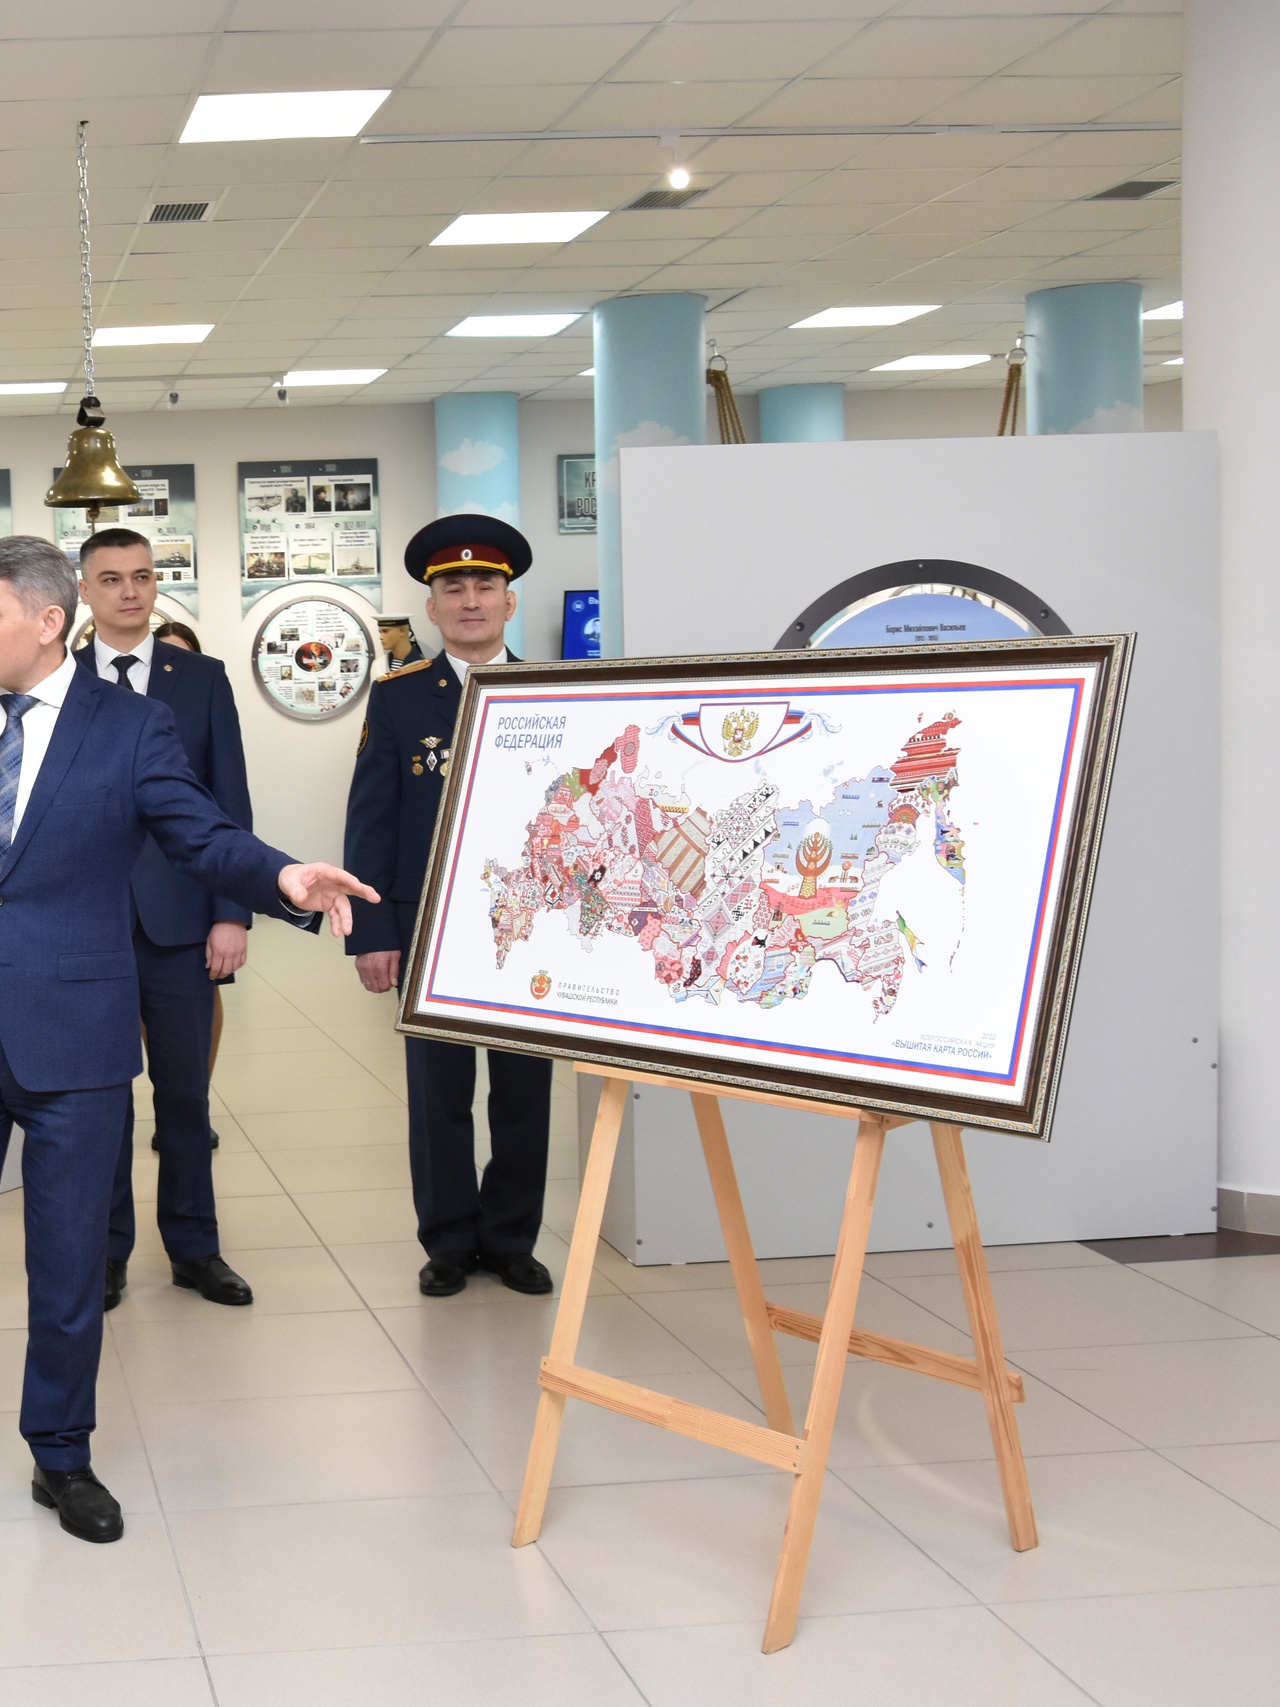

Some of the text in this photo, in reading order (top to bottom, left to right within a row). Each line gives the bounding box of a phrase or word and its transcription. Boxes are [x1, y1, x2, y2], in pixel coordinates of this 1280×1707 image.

[497, 713, 567, 730] РОССИЙСКАЯ
[494, 733, 563, 752] ФЕДЕРАЦИЯ
[557, 981, 621, 997] ПРАВИТЕЛЬСТВО
[556, 991, 619, 1006] ЧУВАШСКОЙ РЕСПУБЛИКИ
[920, 1033, 996, 1049] ВСЕРОССИЙСКАЯ АКЦИЯ
[981, 1032, 996, 1041] 2022
[891, 1039, 993, 1060] «ВЫШИТАЯ КАРТА РОССИИ»
